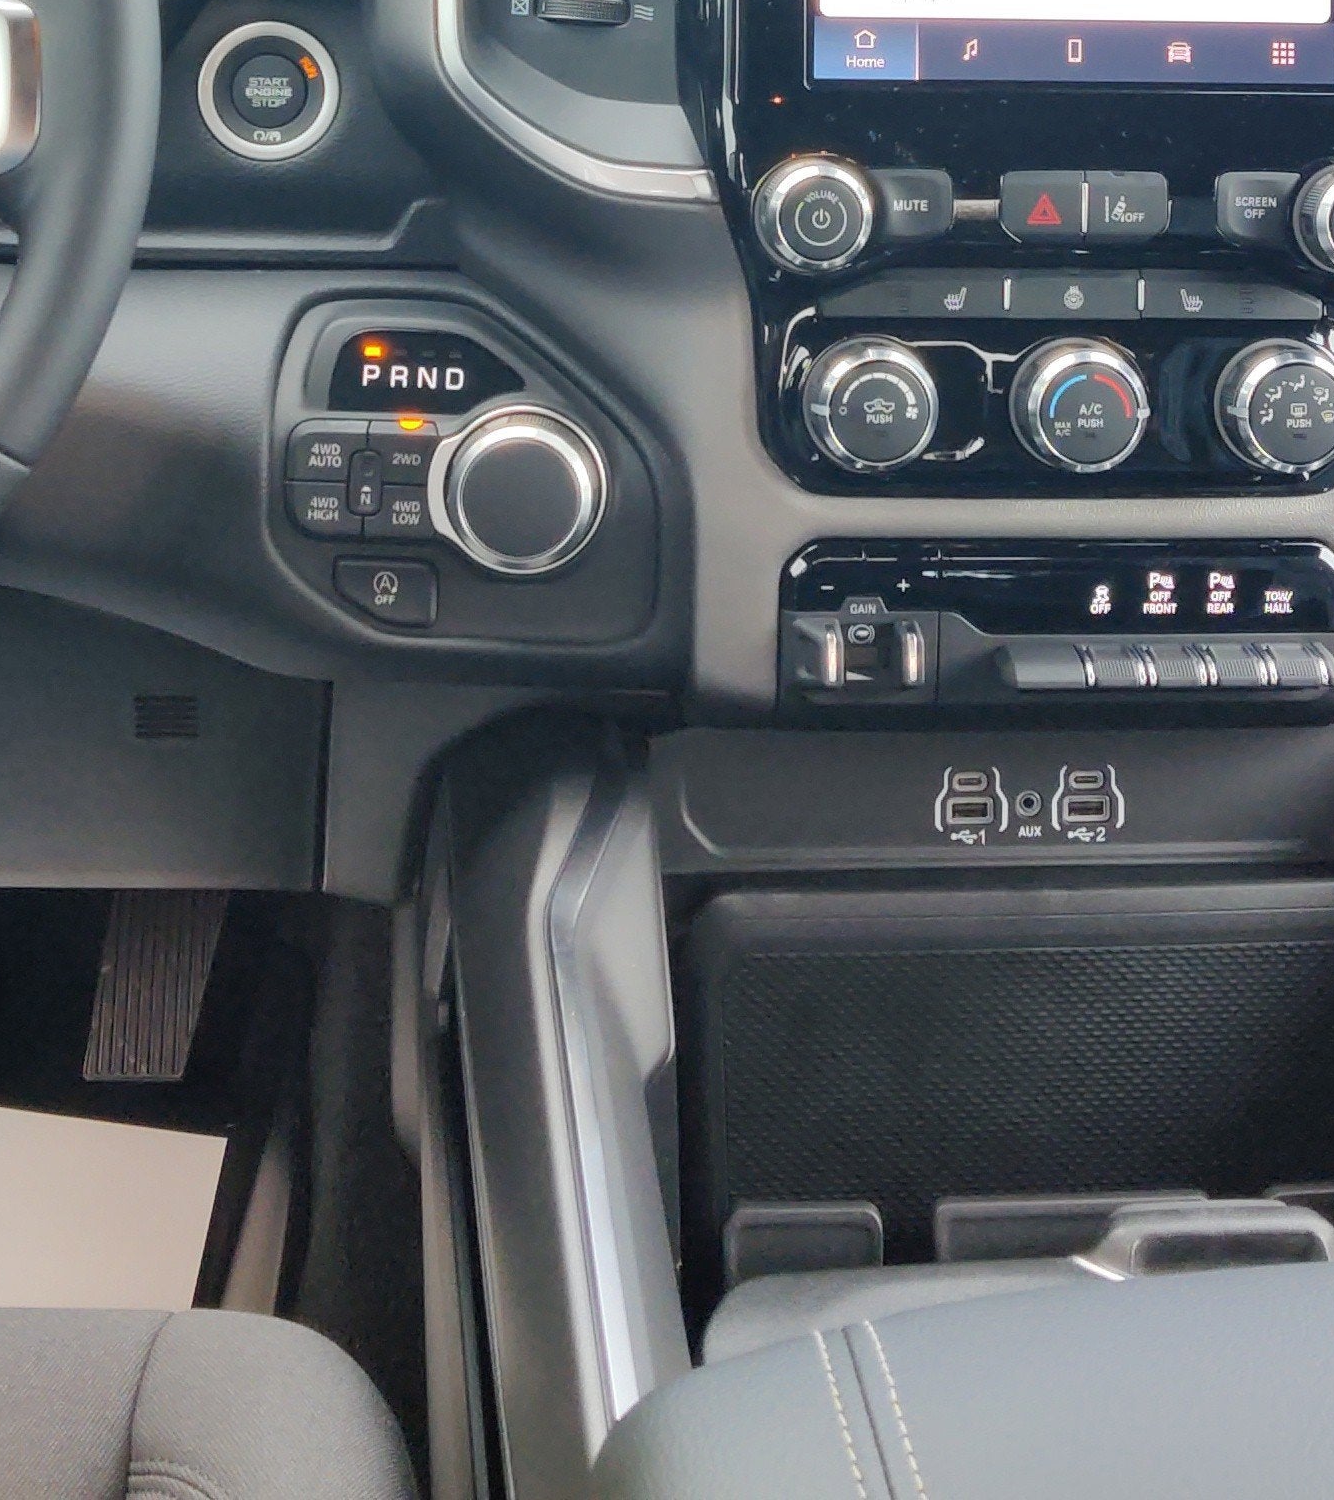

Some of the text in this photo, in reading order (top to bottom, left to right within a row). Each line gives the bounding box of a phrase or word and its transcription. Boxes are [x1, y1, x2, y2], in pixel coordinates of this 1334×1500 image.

[845, 55, 886, 69] Home
[248, 77, 289, 87] START
[245, 88, 293, 97] ENGINE
[252, 98, 287, 108] STOP
[803, 189, 840, 207] VOLUME
[1234, 196, 1278, 208] SCREEN
[893, 200, 929, 212] MUTE
[1243, 208, 1266, 219] OFF
[1078, 402, 1103, 416] A/C
[866, 413, 894, 424] PUSH
[1077, 418, 1105, 429] PUSH
[1286, 418, 1313, 429] PUSH
[311, 443, 342, 455] 4WD
[308, 455, 343, 468] AUTO
[392, 453, 422, 467] 2WD
[309, 496, 339, 509] 4WD
[392, 500, 421, 513] 4WD
[307, 508, 339, 522] HIGH
[392, 512, 420, 526] LOW
[374, 594, 396, 606] OFF
[1150, 591, 1172, 602] OFF
[1210, 591, 1232, 602] OFF
[849, 603, 877, 615] GAIN
[1089, 602, 1112, 615] OFF
[1143, 602, 1178, 615] FRONT
[1206, 602, 1235, 614] REAR
[1264, 602, 1294, 614] HAUL
[978, 829, 986, 845] 1
[1018, 825, 1042, 838] AUX
[1094, 827, 1106, 842] 2
